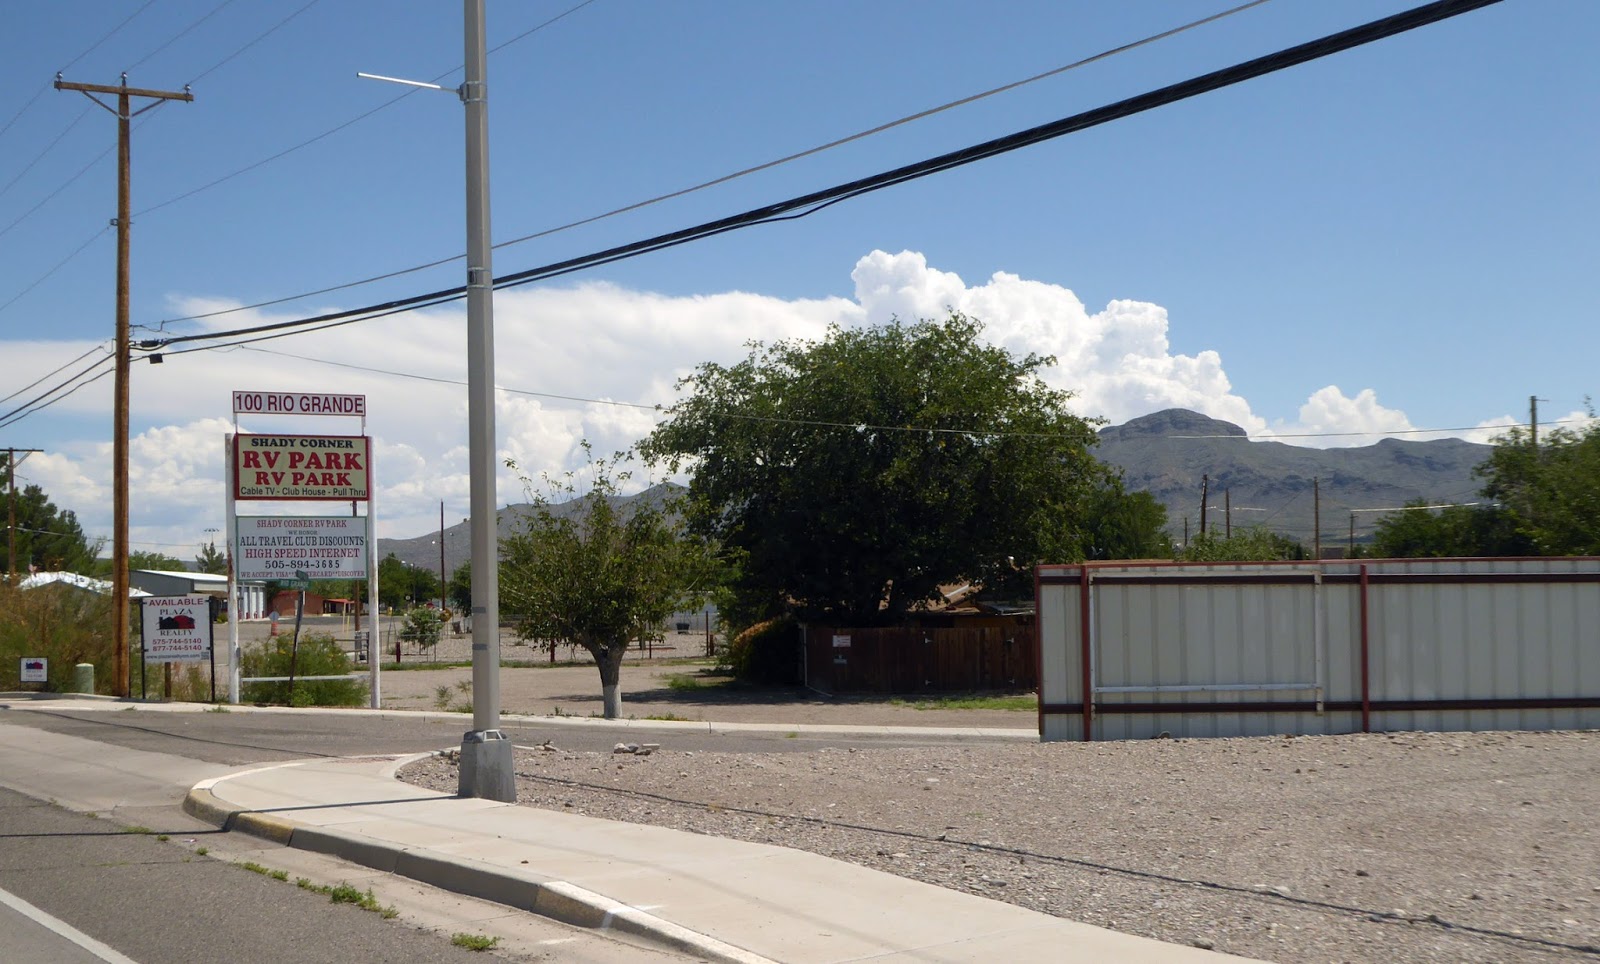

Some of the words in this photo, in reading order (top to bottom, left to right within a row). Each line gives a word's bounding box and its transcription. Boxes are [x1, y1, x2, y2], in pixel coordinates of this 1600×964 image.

[236, 394, 262, 411] 100
[267, 395, 294, 412] RIO
[300, 395, 363, 413] GRANDE
[251, 438, 296, 448] SHADY
[300, 439, 353, 449] CORNER
[243, 451, 280, 469] RV
[288, 452, 363, 470] PARK
[255, 472, 286, 486] RV
[291, 472, 352, 486] PARK
[240, 487, 263, 495] Cable
[265, 487, 275, 495] TV
[282, 487, 300, 496] Club
[303, 488, 326, 496] House
[333, 488, 347, 496] Pull
[349, 488, 366, 496] Thru
[257, 520, 282, 528] SHADY
[284, 520, 313, 528] CORNER
[315, 520, 325, 528] RV
[326, 520, 347, 528] PARK
[240, 537, 257, 547] ALL
[259, 537, 294, 546] TRAVEL
[296, 537, 317, 546] CLUB
[320, 536, 364, 546] DISCOUNTS
[245, 549, 272, 559] HIGH
[274, 549, 307, 558] SPEED
[309, 548, 360, 558] INTERNET
[265, 560, 340, 569] 505-894-3685
[149, 598, 204, 606] AVAILABLE
